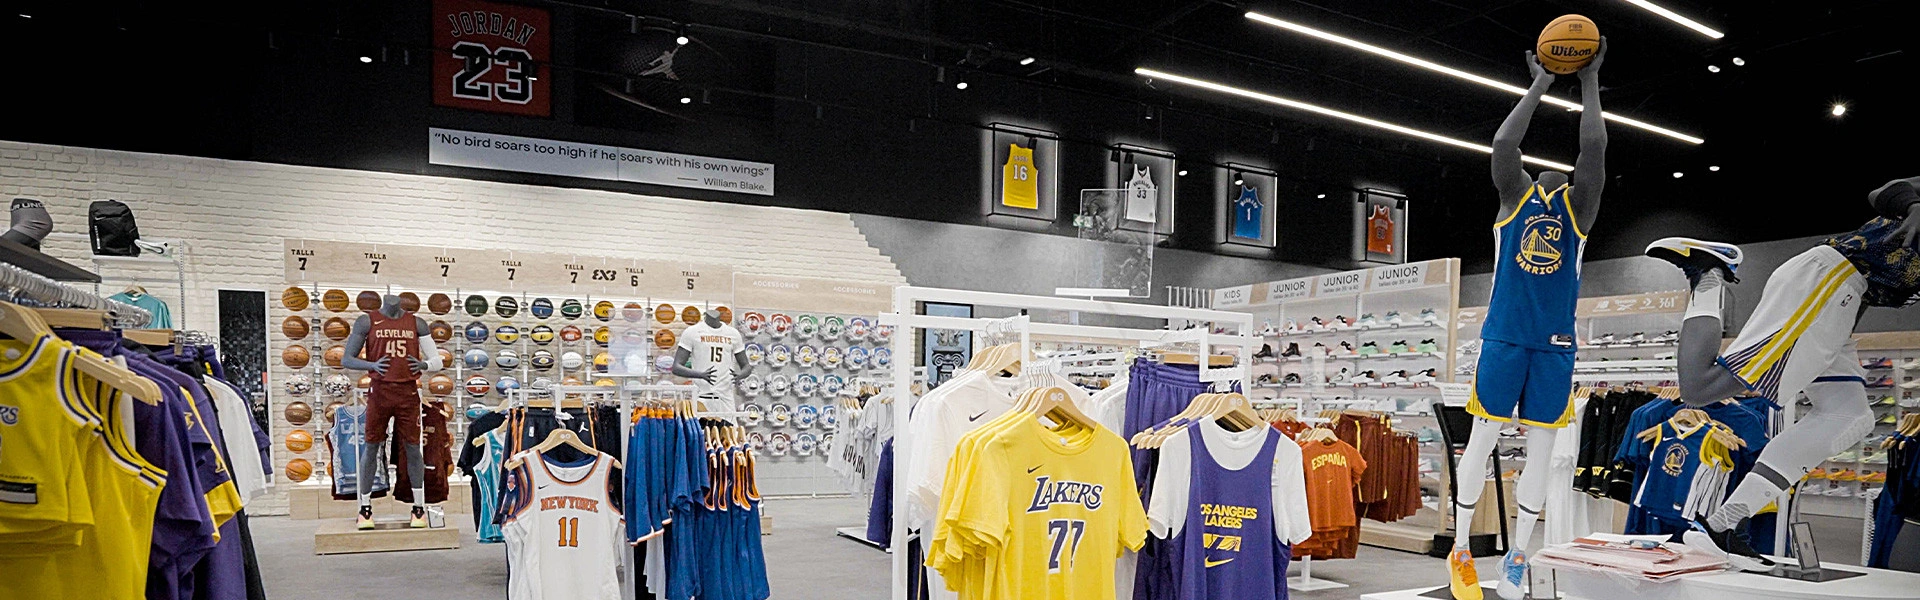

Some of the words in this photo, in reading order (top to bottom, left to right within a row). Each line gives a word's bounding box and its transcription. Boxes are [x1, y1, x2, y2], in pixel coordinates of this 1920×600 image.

[448, 11, 536, 46] JORDAN
[1551, 46, 1592, 56] Wilson
[452, 41, 533, 105] 23
[464, 136, 491, 148] bird
[495, 140, 530, 152] soars
[534, 143, 555, 154] too
[558, 146, 586, 159] high
[590, 148, 598, 159] if
[601, 150, 617, 161] he
[620, 153, 653, 164] soars
[656, 156, 680, 168] with
[684, 158, 700, 170] his
[703, 162, 728, 172] own
[1013, 164, 1028, 181] 16
[704, 177, 738, 188] William
[740, 180, 767, 192] Blake.
[1544, 226, 1562, 241] 30
[291, 248, 314, 256] TALLA
[364, 252, 386, 260] TALLA
[298, 257, 308, 270] 7
[371, 260, 380, 274] 7
[434, 256, 456, 264] TALLA
[440, 264, 449, 277] 7
[508, 268, 516, 280] 7
[1378, 266, 1418, 280] JUNIOR
[570, 272, 578, 284] 7
[630, 275, 638, 287] 6
[687, 278, 694, 290] 5
[1324, 274, 1360, 287] JUNIOR
[1274, 281, 1306, 293] JUNIOR
[1224, 290, 1241, 299] KIDS
[376, 329, 415, 339] CLEVELAND
[700, 336, 732, 344] NUGGETS
[386, 340, 407, 358] 45
[710, 346, 723, 362] 15
[1312, 452, 1347, 470] ESPAÑA
[1026, 475, 1104, 514] LAKERS
[540, 496, 568, 512] NEW
[568, 496, 598, 514] YORK
[1200, 504, 1212, 515] OS
[1212, 504, 1258, 520] ANGELES
[1204, 515, 1242, 529] LAKERS
[558, 516, 578, 548] 11
